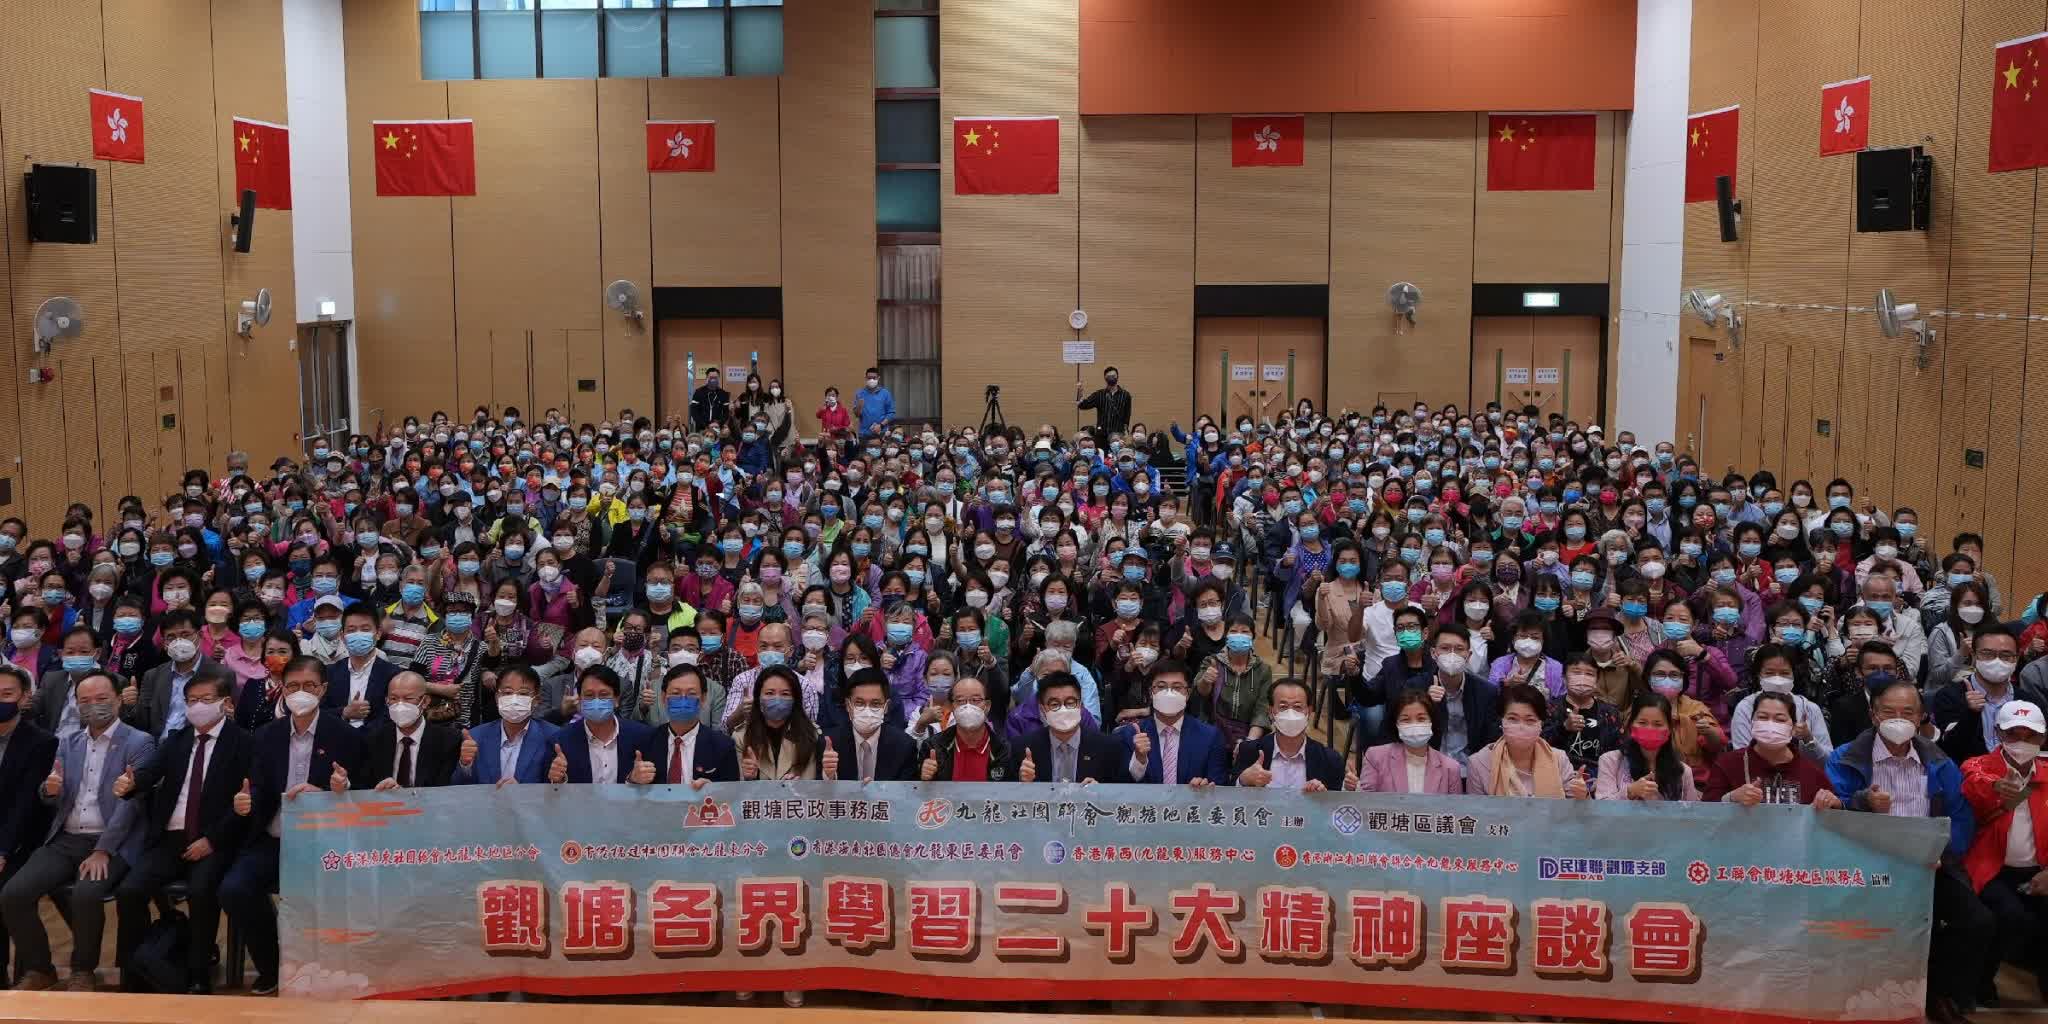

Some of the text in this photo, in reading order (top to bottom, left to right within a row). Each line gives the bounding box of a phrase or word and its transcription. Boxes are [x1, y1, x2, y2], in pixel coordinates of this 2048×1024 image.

[742, 800, 890, 821] 觀塘民政事務處
[1368, 812, 1510, 836] 觀塘區議會 支持
[482, 880, 1701, 974] 觀塘各界學習二十大精神座談會
